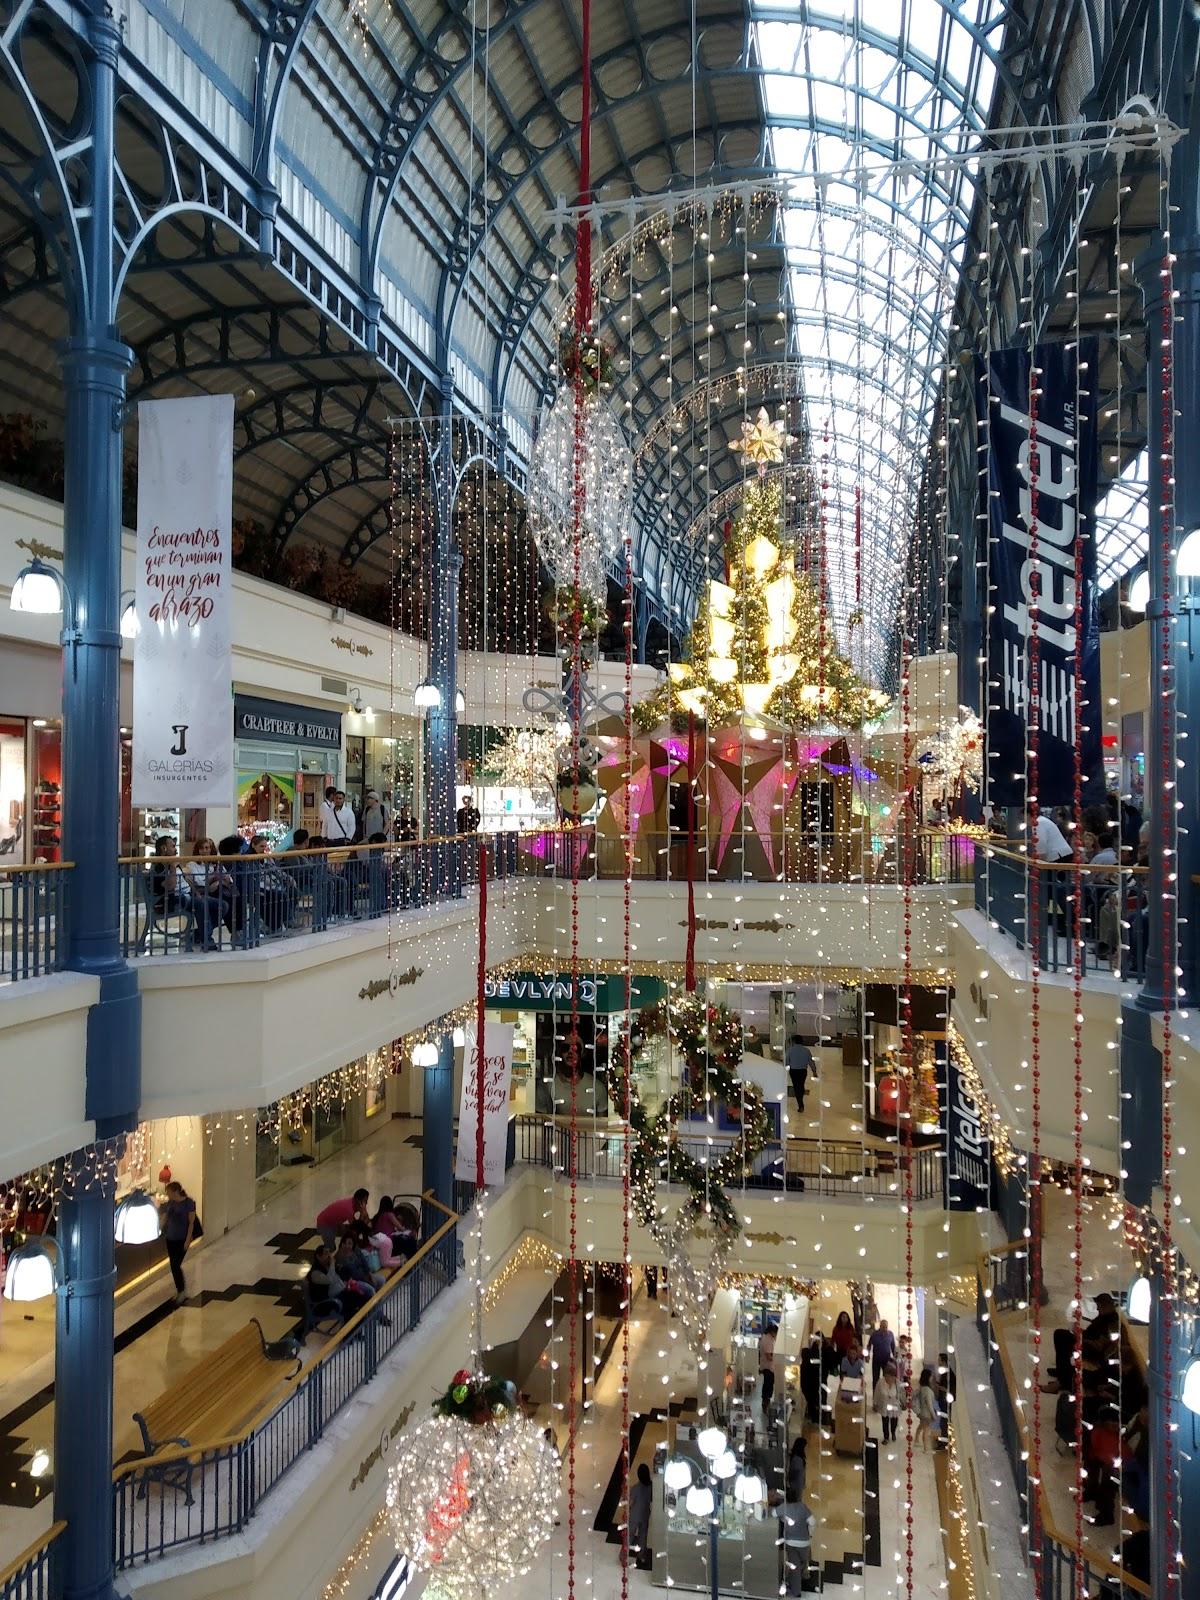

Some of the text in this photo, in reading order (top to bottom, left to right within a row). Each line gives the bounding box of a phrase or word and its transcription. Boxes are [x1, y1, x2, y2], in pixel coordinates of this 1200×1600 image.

[1063, 401, 1075, 430] M.R.
[147, 526, 219, 549] Encuentros
[1001, 403, 1077, 652] telcel
[145, 550, 222, 575] que terminan
[146, 572, 220, 596] en un gran
[149, 589, 214, 628] abrazo
[243, 713, 339, 741] CRABTREE & EVELYN
[484, 980, 572, 999] DEVLYN
[470, 1048, 505, 1070] Dseos
[470, 1069, 504, 1086] qe se
[465, 1081, 506, 1101] vulven
